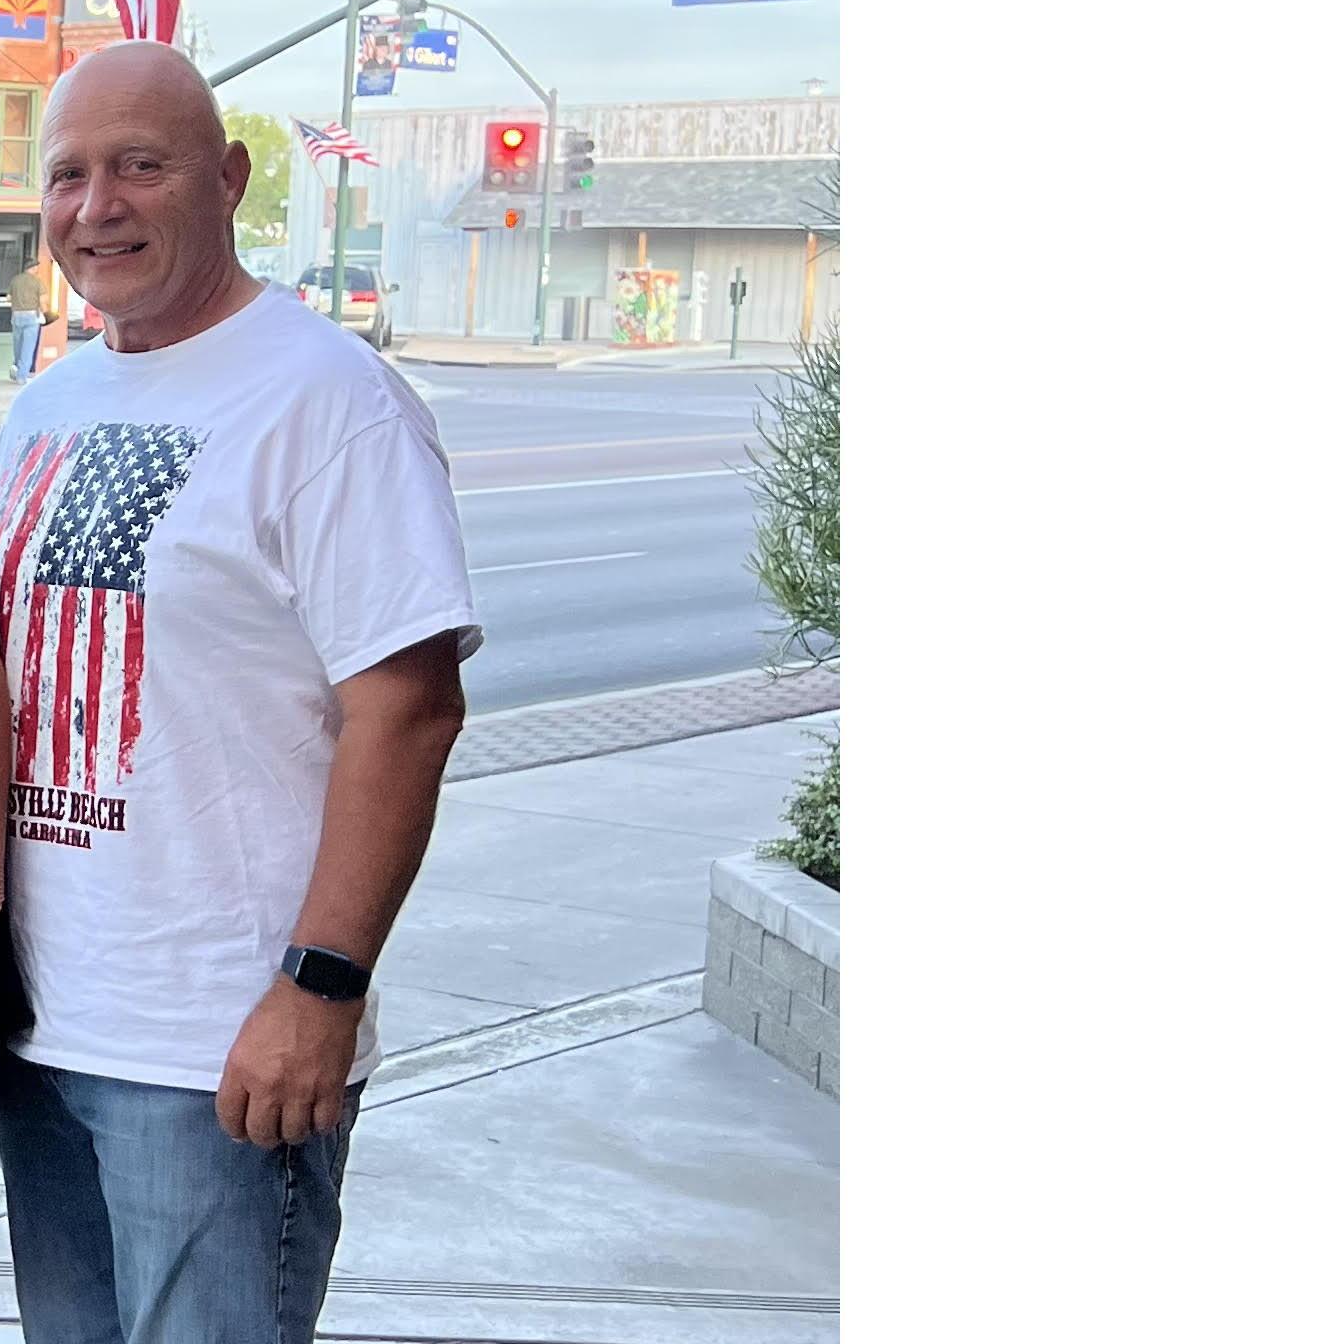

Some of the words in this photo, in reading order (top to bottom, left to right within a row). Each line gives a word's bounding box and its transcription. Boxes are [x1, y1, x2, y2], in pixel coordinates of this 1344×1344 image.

[7, 782, 67, 821] SVILLE
[68, 790, 127, 832] BEACH
[19, 820, 92, 850] CAROLINA
